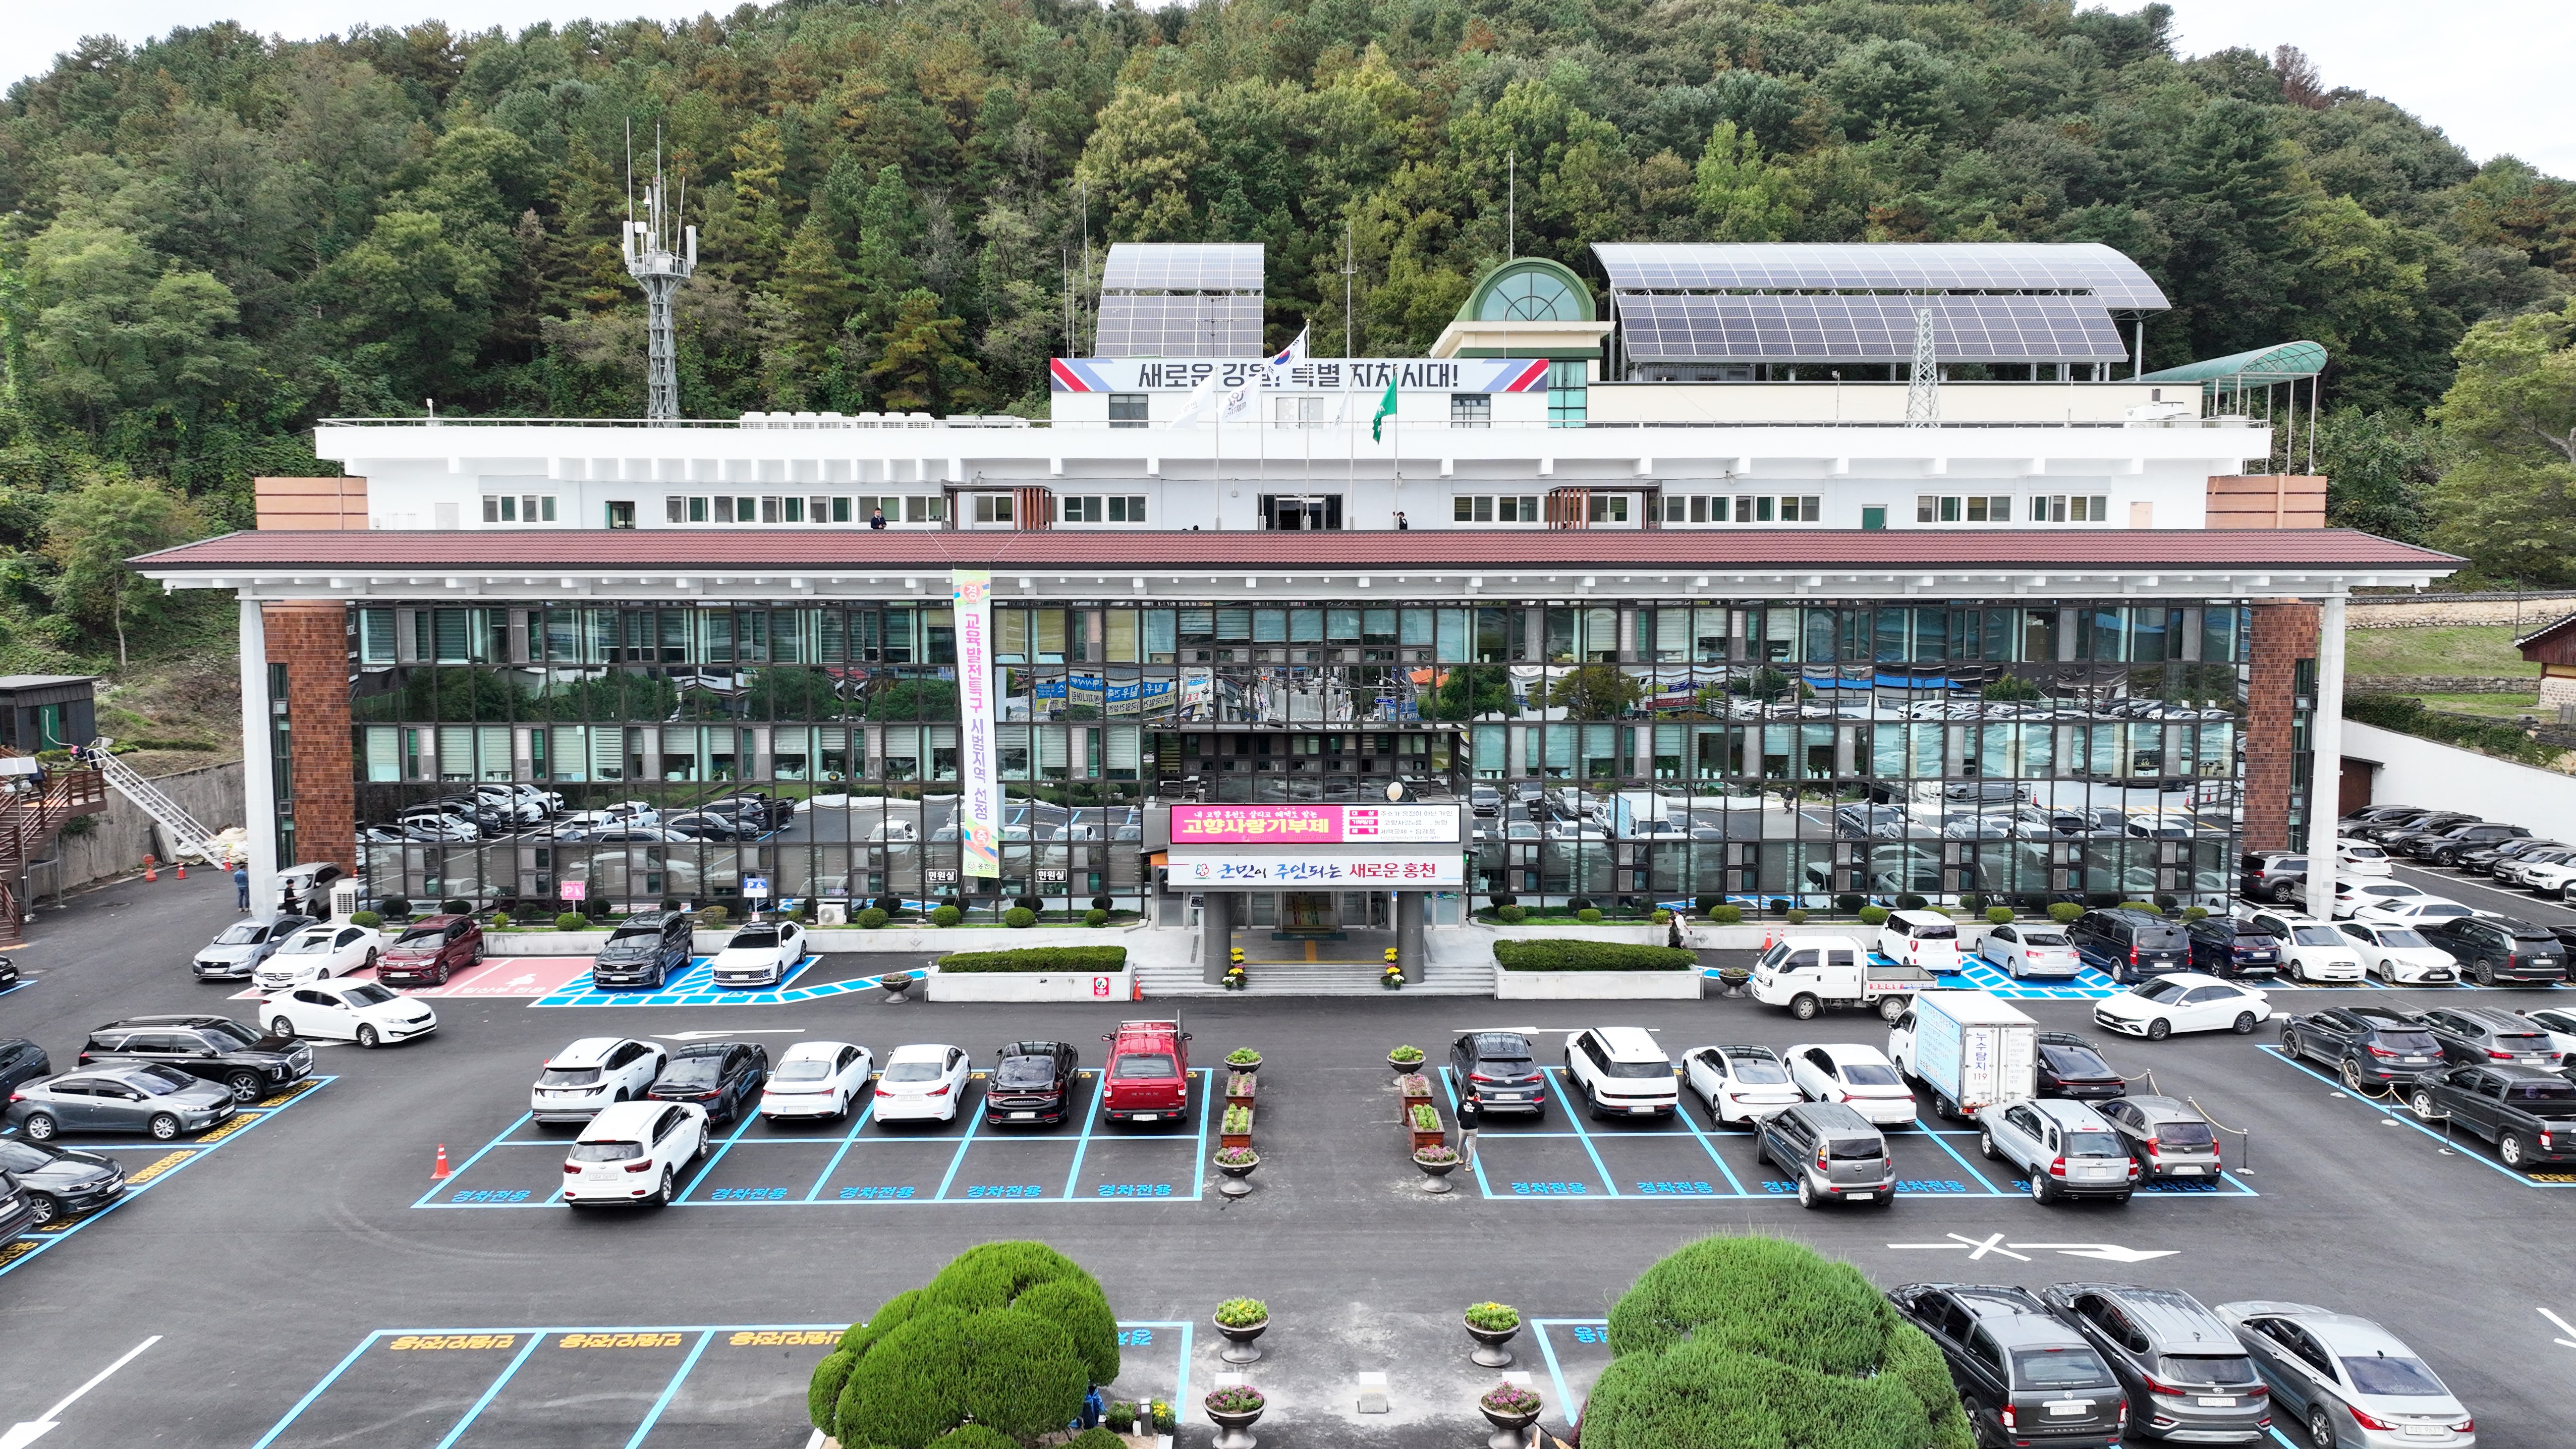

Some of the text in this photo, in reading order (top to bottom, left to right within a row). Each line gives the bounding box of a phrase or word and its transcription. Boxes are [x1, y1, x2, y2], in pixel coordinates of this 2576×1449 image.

[1138, 363, 1213, 387] 새로운
[1292, 363, 1340, 387] 특별
[1349, 362, 1458, 387] 자치시대!
[966, 585, 978, 600] 경
[965, 613, 988, 820] 교육발전특구 시범지역 선정
[1194, 810, 1317, 818] 내 고향 홍천도 살리고 혜택도 받는
[1182, 818, 1329, 834] 고향사랑기부제
[976, 828, 987, 844] 축
[928, 871, 955, 882] 민원실
[1038, 871, 1065, 881] 민원실
[1217, 862, 1435, 880] 군민이 주인되는 새로운 홍천
[565, 886, 573, 896] P
[1975, 1032, 1987, 1071] 누수탐지
[125, 1150, 197, 1184] 민원인전용
[711, 1187, 788, 1202] 경차전용
[839, 1186, 915, 1200] 경차전용
[967, 1185, 1041, 1199] 경차전용
[1098, 1184, 1171, 1198] 경차전용
[1511, 1181, 1586, 1196] 경차전용
[1638, 1181, 1713, 1196] 경차전용
[1762, 1181, 1799, 1195] 경차
[452, 1190, 531, 1203] 경차전용
